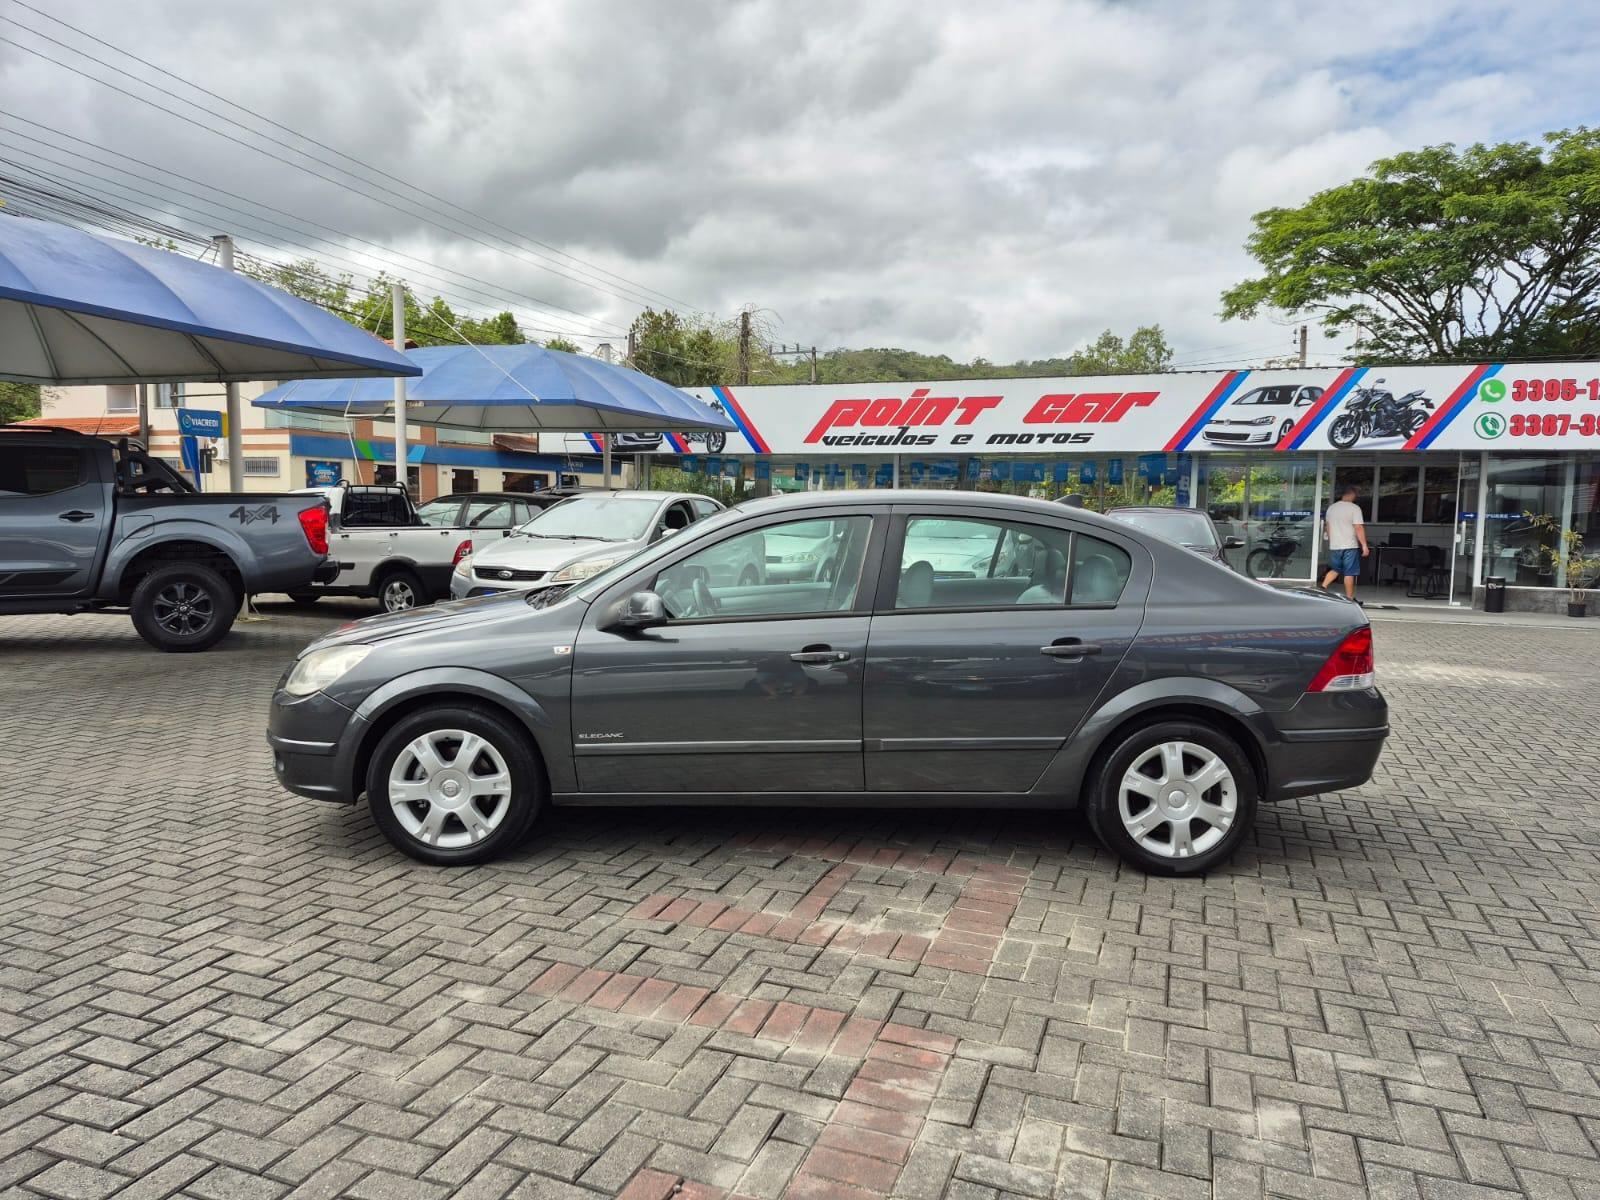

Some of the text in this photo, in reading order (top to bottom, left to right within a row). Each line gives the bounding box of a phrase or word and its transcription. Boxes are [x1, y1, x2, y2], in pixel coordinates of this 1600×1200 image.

[1511, 378, 1600, 402] 3395-1
[191, 418, 219, 427] VIACREDI
[950, 434, 973, 444] e
